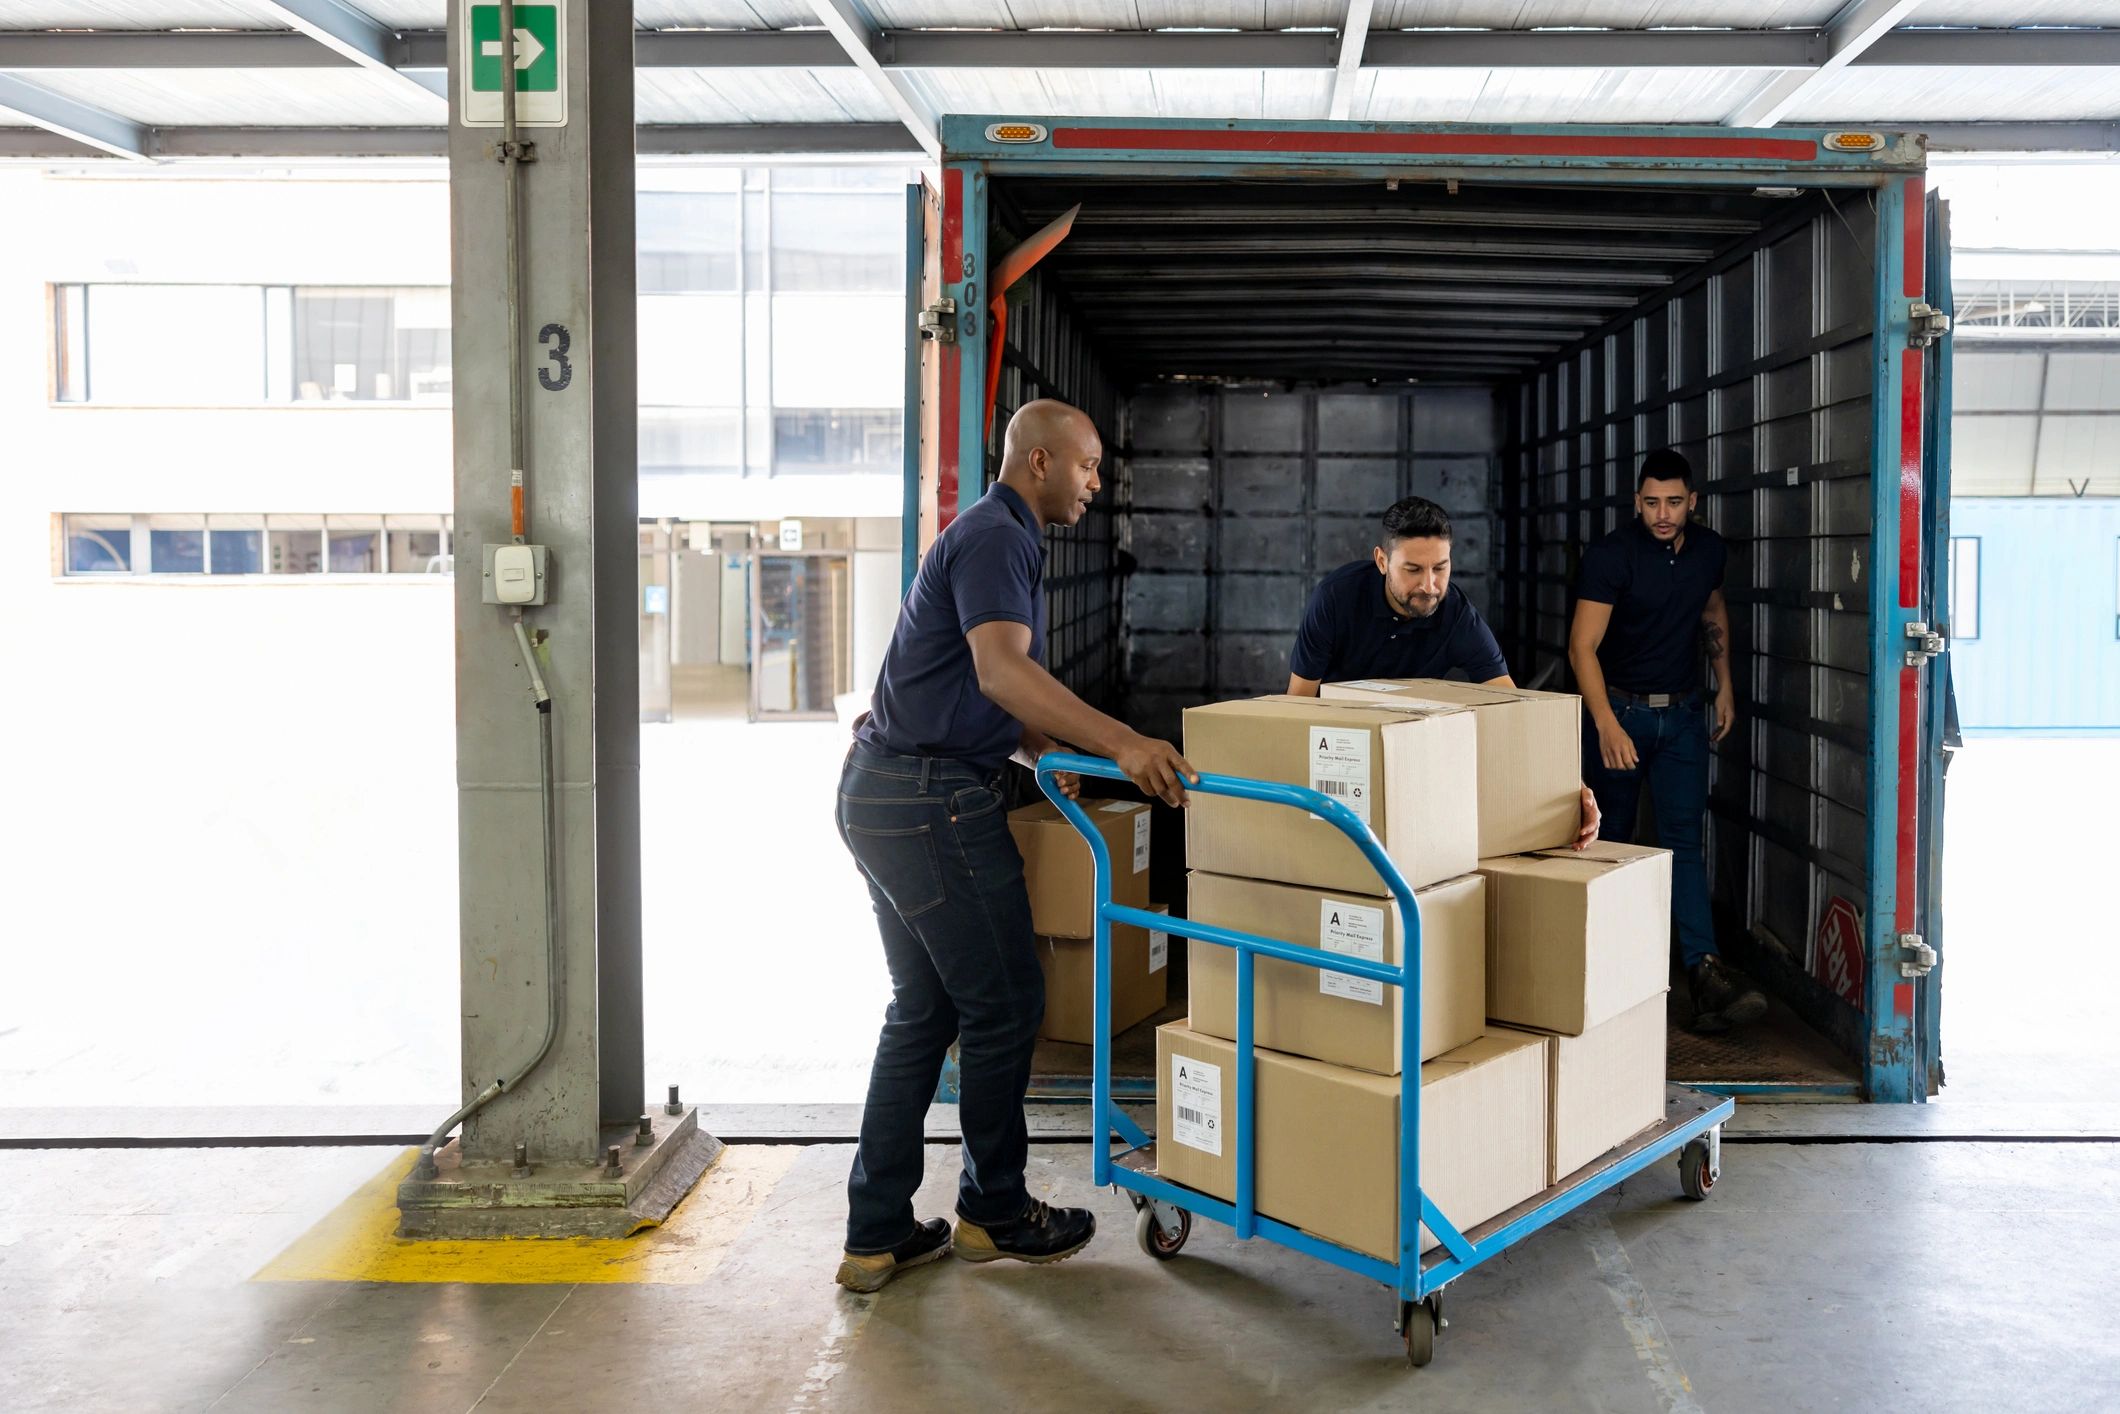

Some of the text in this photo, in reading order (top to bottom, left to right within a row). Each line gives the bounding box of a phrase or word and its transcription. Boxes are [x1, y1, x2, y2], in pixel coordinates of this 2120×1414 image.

[963, 252, 977, 337] 303
[538, 323, 572, 392] 3
[1319, 737, 1328, 751] A
[1330, 911, 1340, 926] A
[1330, 929, 1345, 937] Priority
[1823, 912, 1857, 1006] ARE
[1179, 1066, 1187, 1079] A
